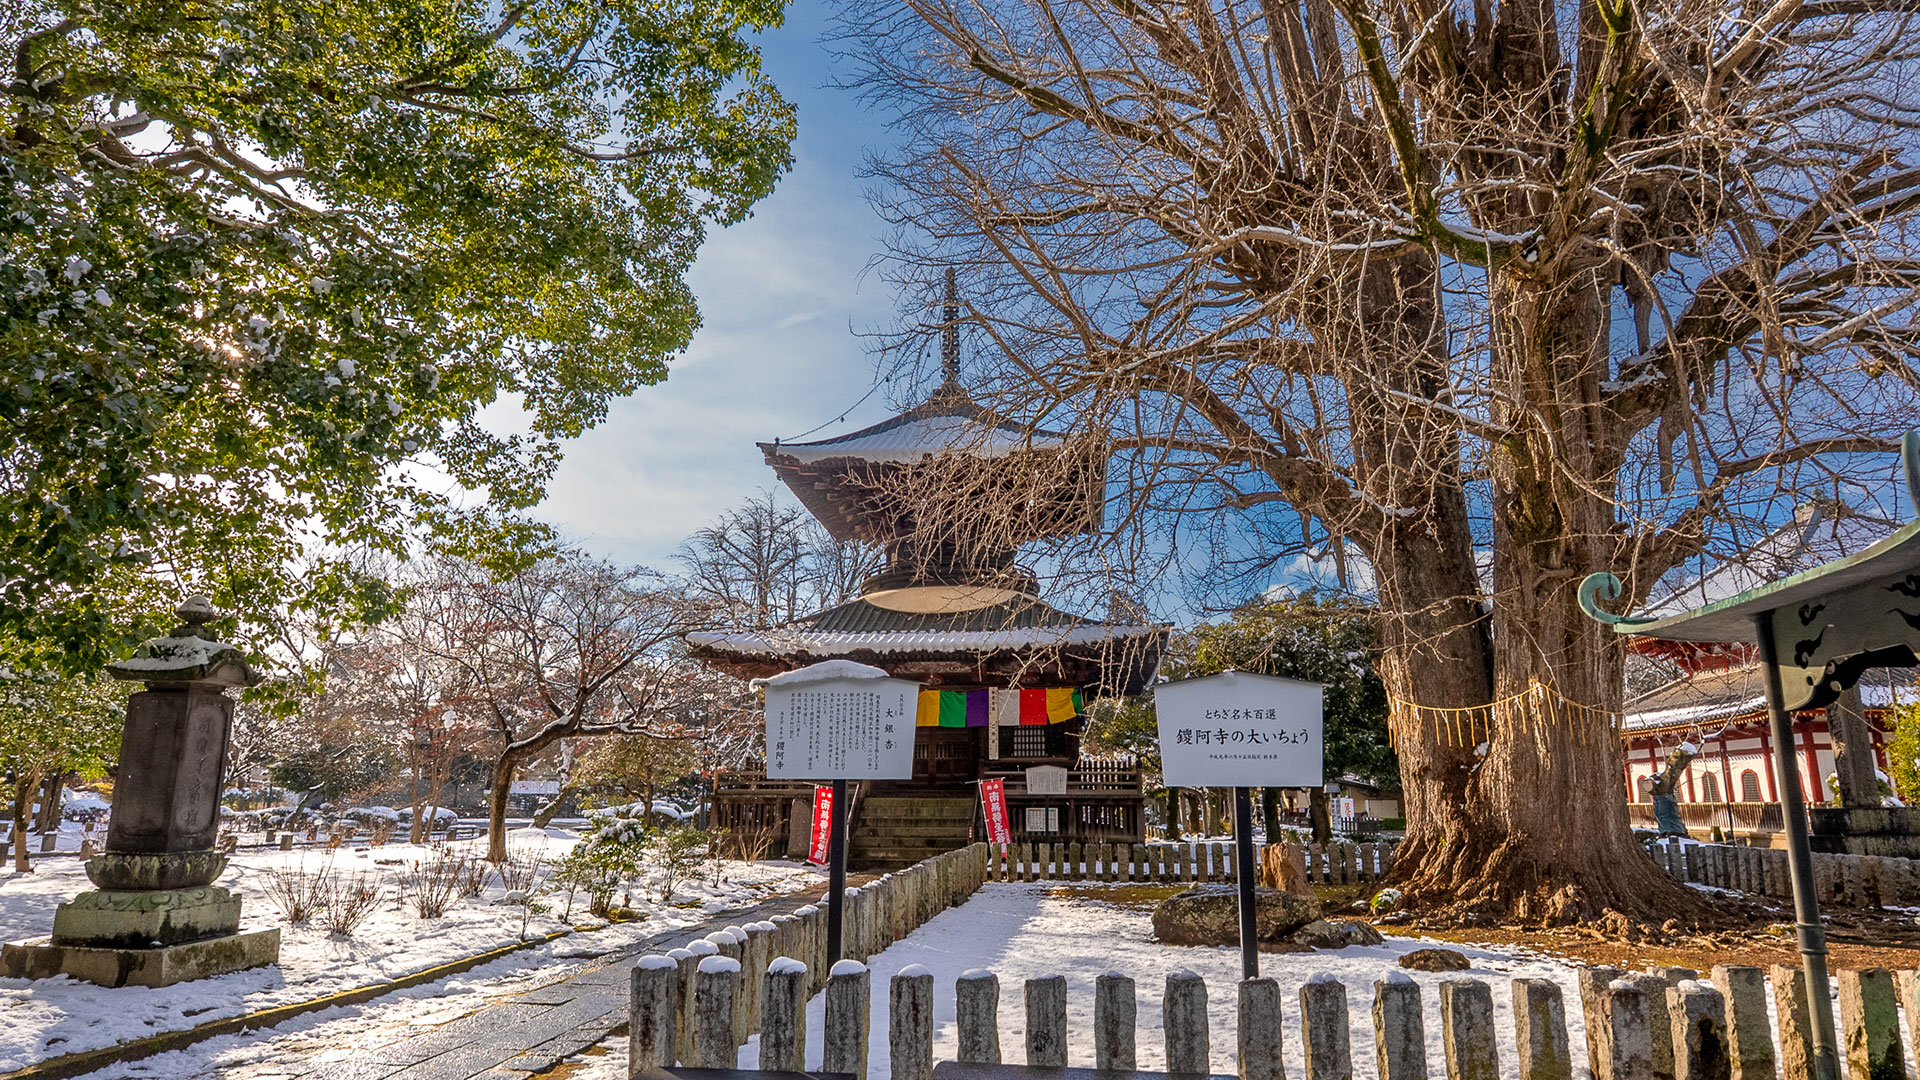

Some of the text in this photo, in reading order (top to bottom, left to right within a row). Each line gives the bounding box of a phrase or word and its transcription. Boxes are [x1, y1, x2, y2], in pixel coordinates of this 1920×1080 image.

[1204, 709, 1277, 720] とちぎ名木百選
[885, 708, 894, 750] 大銀杏
[1176, 728, 1309, 745] 鑁阿寺の大いちょう
[776, 742, 785, 770] 鑁阿寺
